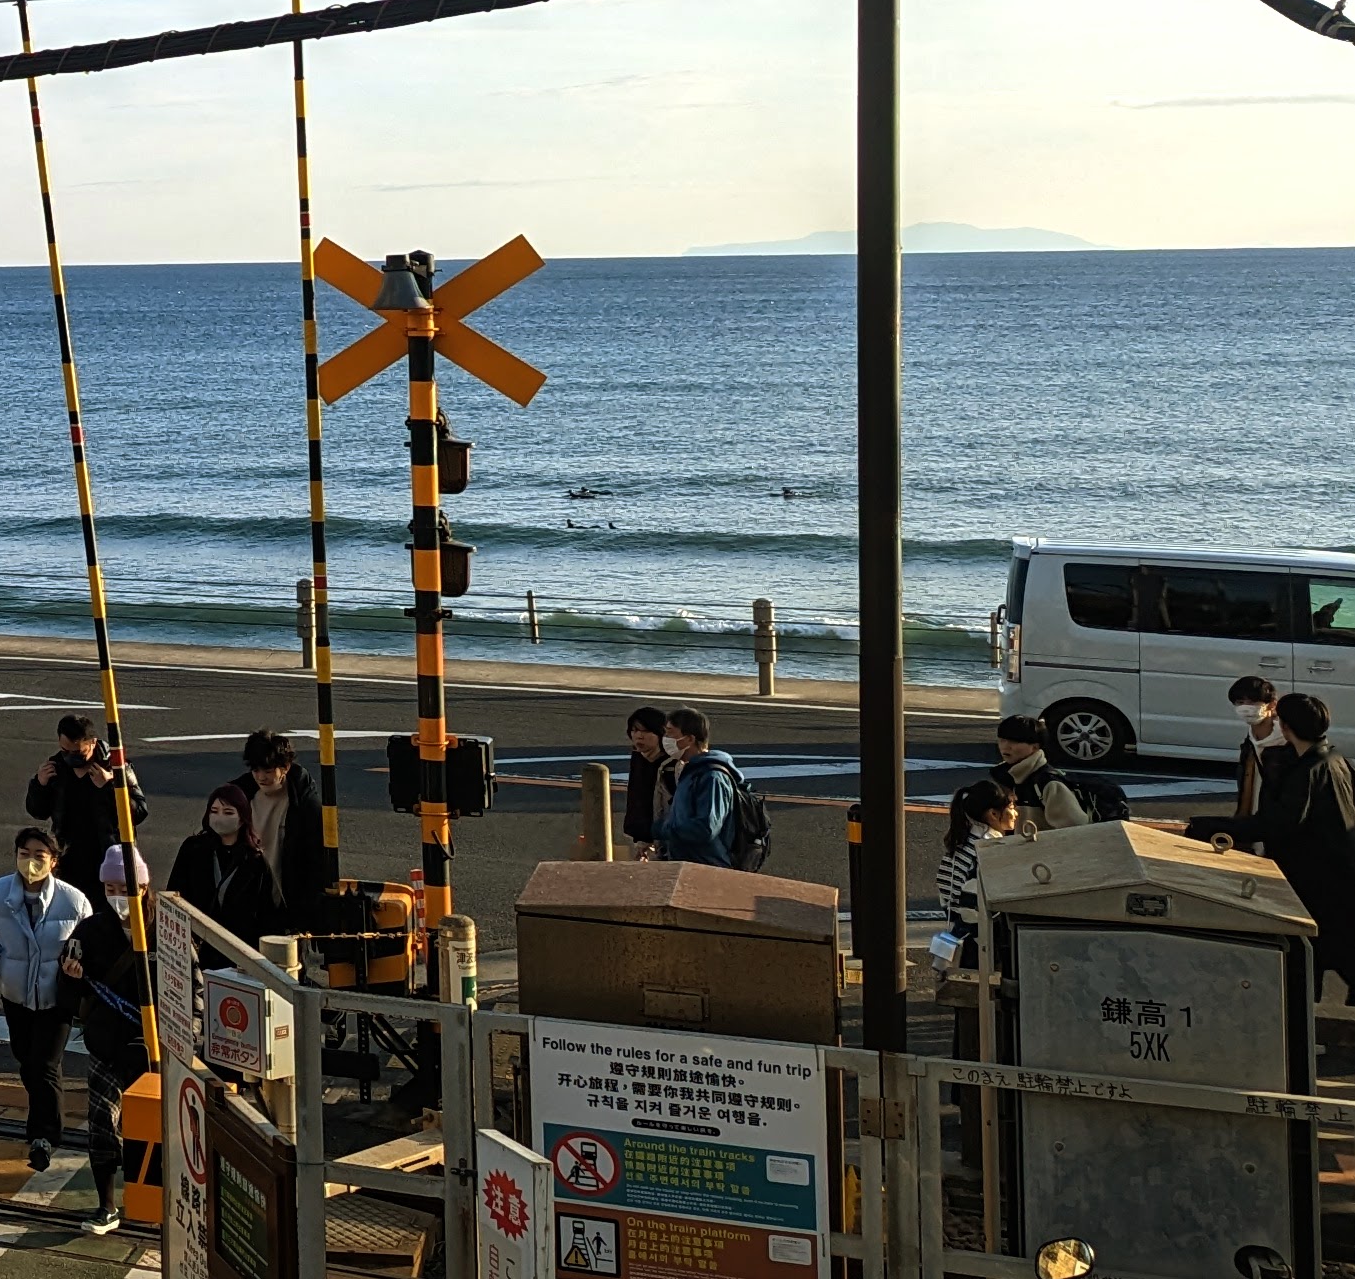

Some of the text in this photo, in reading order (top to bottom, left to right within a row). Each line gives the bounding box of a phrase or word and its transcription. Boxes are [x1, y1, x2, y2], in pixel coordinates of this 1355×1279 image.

[1101, 996, 1193, 1028] 鎌高 1
[210, 1042, 259, 1065] 非常ボタン
[542, 1037, 812, 1080] Follow the rules for a safe and fun trip
[1130, 1031, 1170, 1062] 5XK
[587, 1094, 629, 1111] 규칙을
[634, 1099, 662, 1115] 지켜
[624, 1138, 755, 1163] Around the train tracks
[492, 1184, 521, 1227] 注意
[627, 1217, 751, 1243] On the train platform
